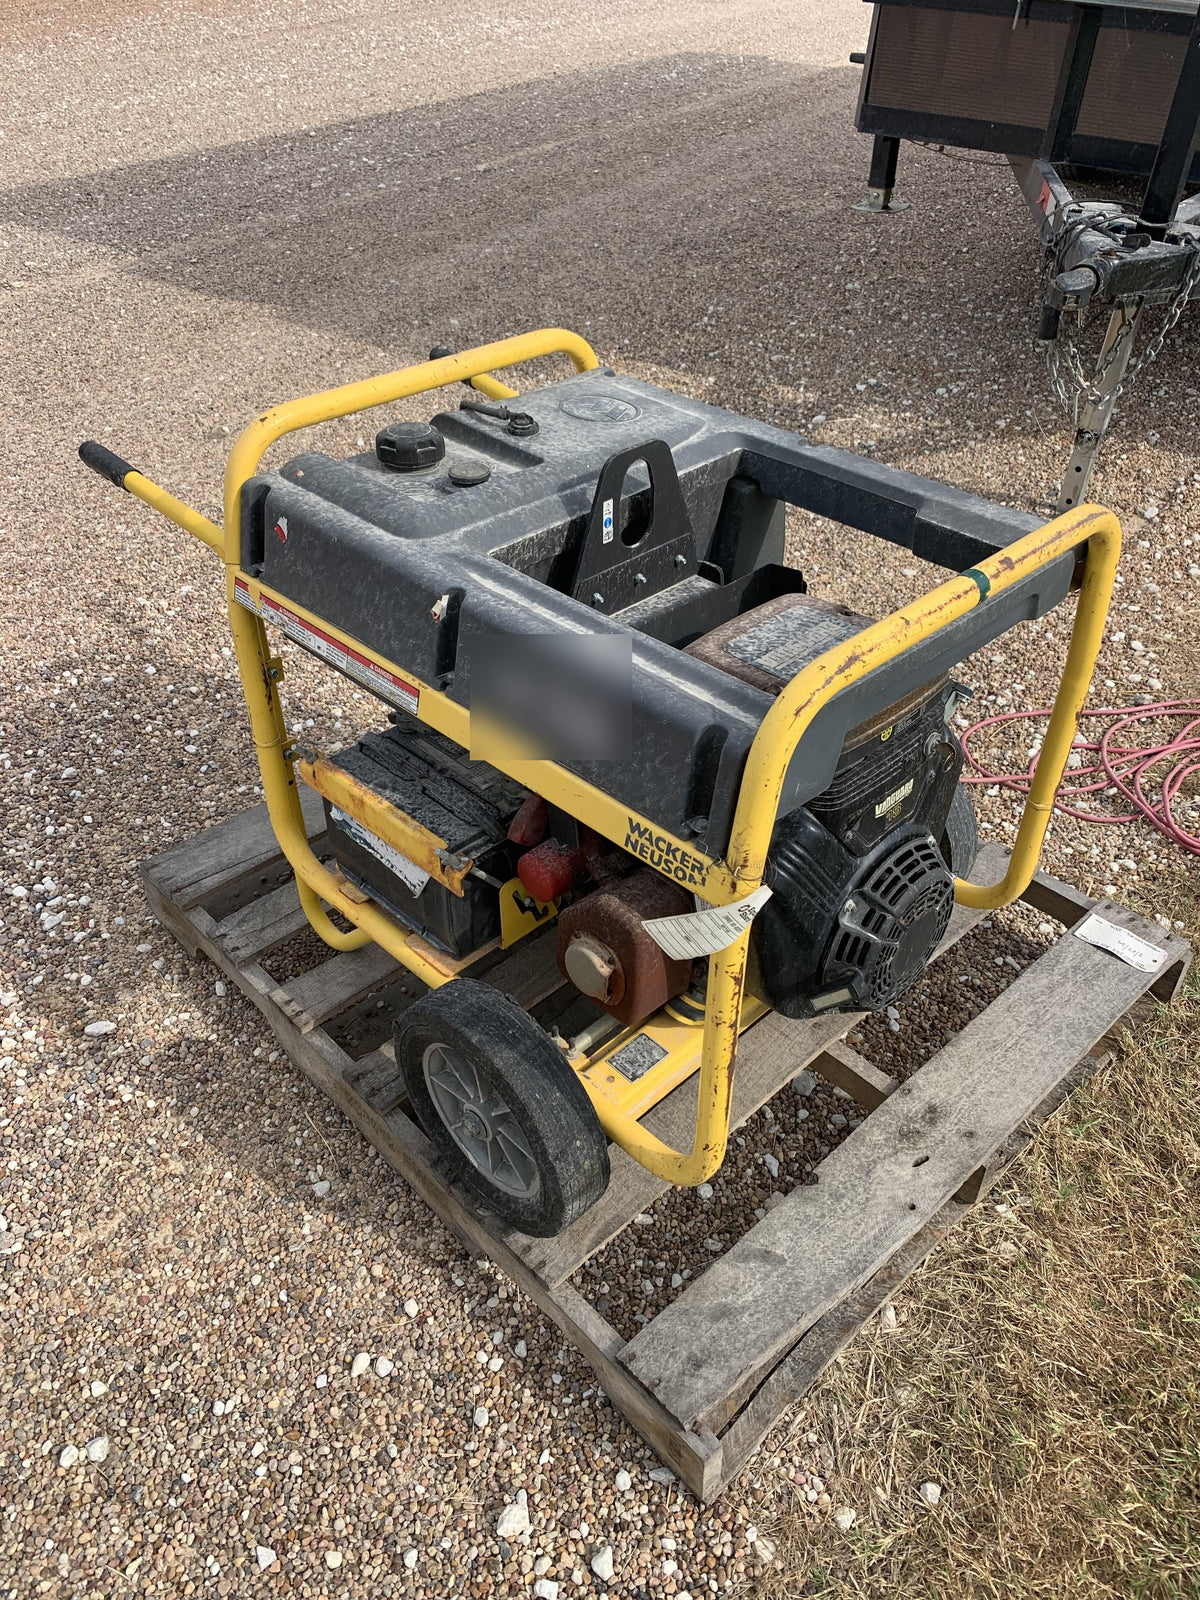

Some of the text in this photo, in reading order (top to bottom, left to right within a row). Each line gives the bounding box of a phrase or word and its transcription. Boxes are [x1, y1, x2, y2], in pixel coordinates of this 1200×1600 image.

[374, 665, 393, 681] DANGER
[624, 833, 707, 887] NEUSON
[628, 816, 704, 875] WACKER
